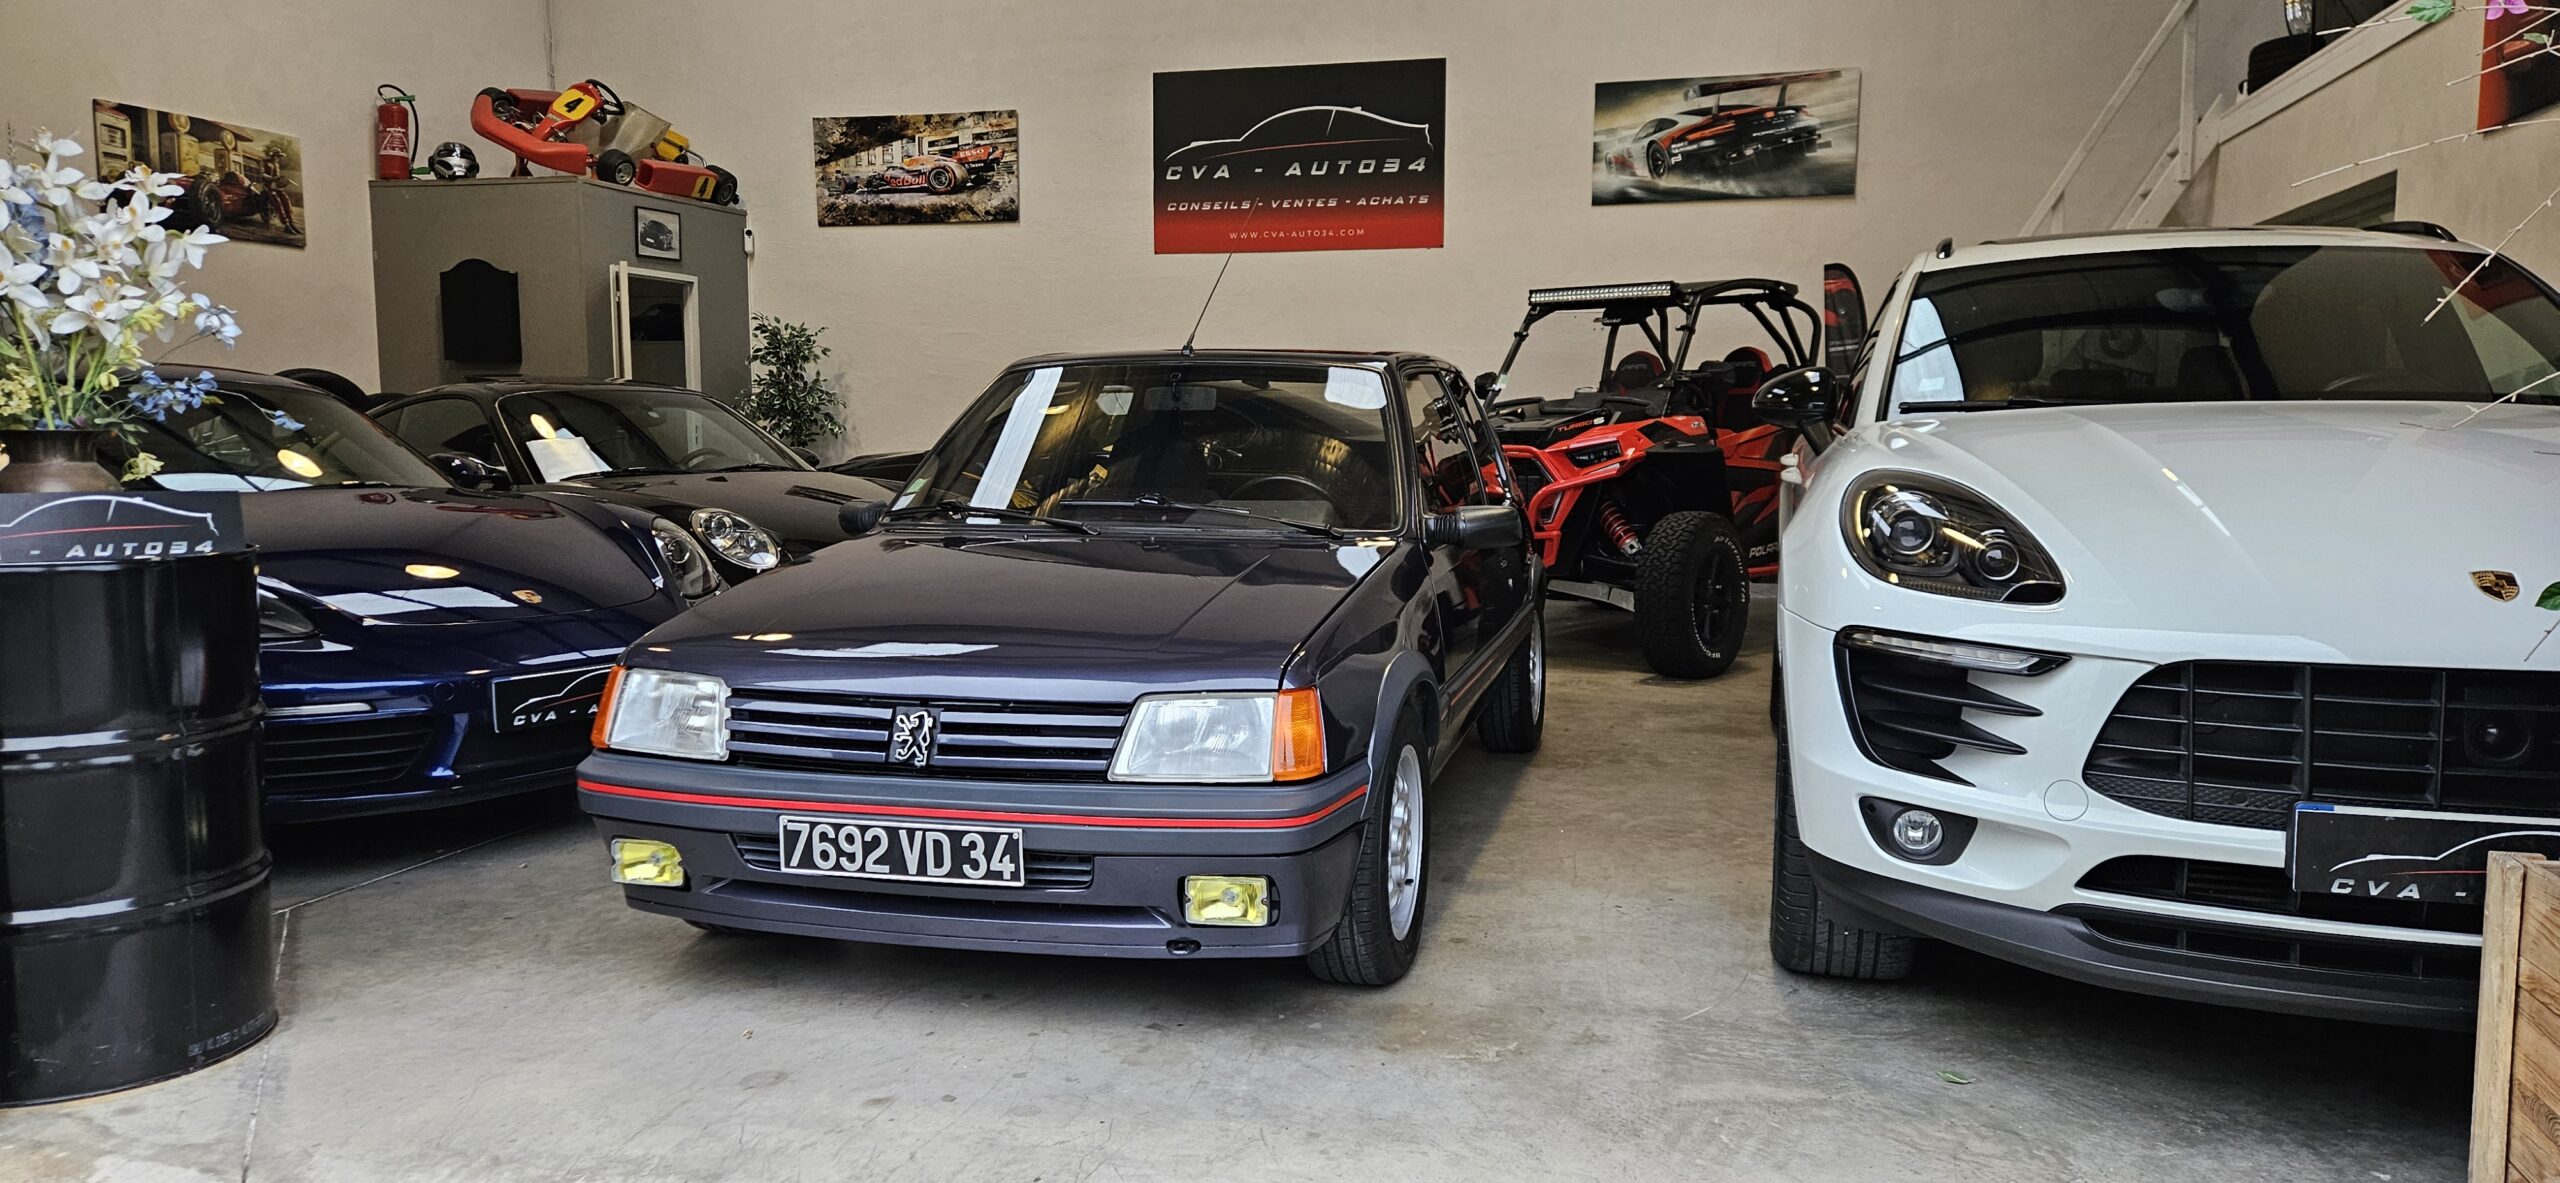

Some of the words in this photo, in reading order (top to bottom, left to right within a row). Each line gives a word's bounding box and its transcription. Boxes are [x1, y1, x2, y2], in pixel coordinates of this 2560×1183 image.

[563, 97, 585, 114] 4
[1165, 164, 1231, 181] CVA
[1284, 156, 1427, 177] AUTO34
[698, 177, 709, 197] 4
[1167, 200, 1252, 211] CONSEILS
[1271, 197, 1339, 209] VENTES
[1356, 195, 1430, 206] ACHATS
[1229, 228, 1365, 239] WWW.CVA-AUTO34.COM
[1557, 420, 1592, 432] TURBO
[1593, 416, 1605, 425] S
[64, 540, 214, 559] AUTO34
[513, 710, 557, 726] CVA
[786, 822, 890, 875] 7692
[898, 829, 952, 877] VD
[961, 832, 1016, 881] 34
[2330, 878, 2421, 899] CVA
